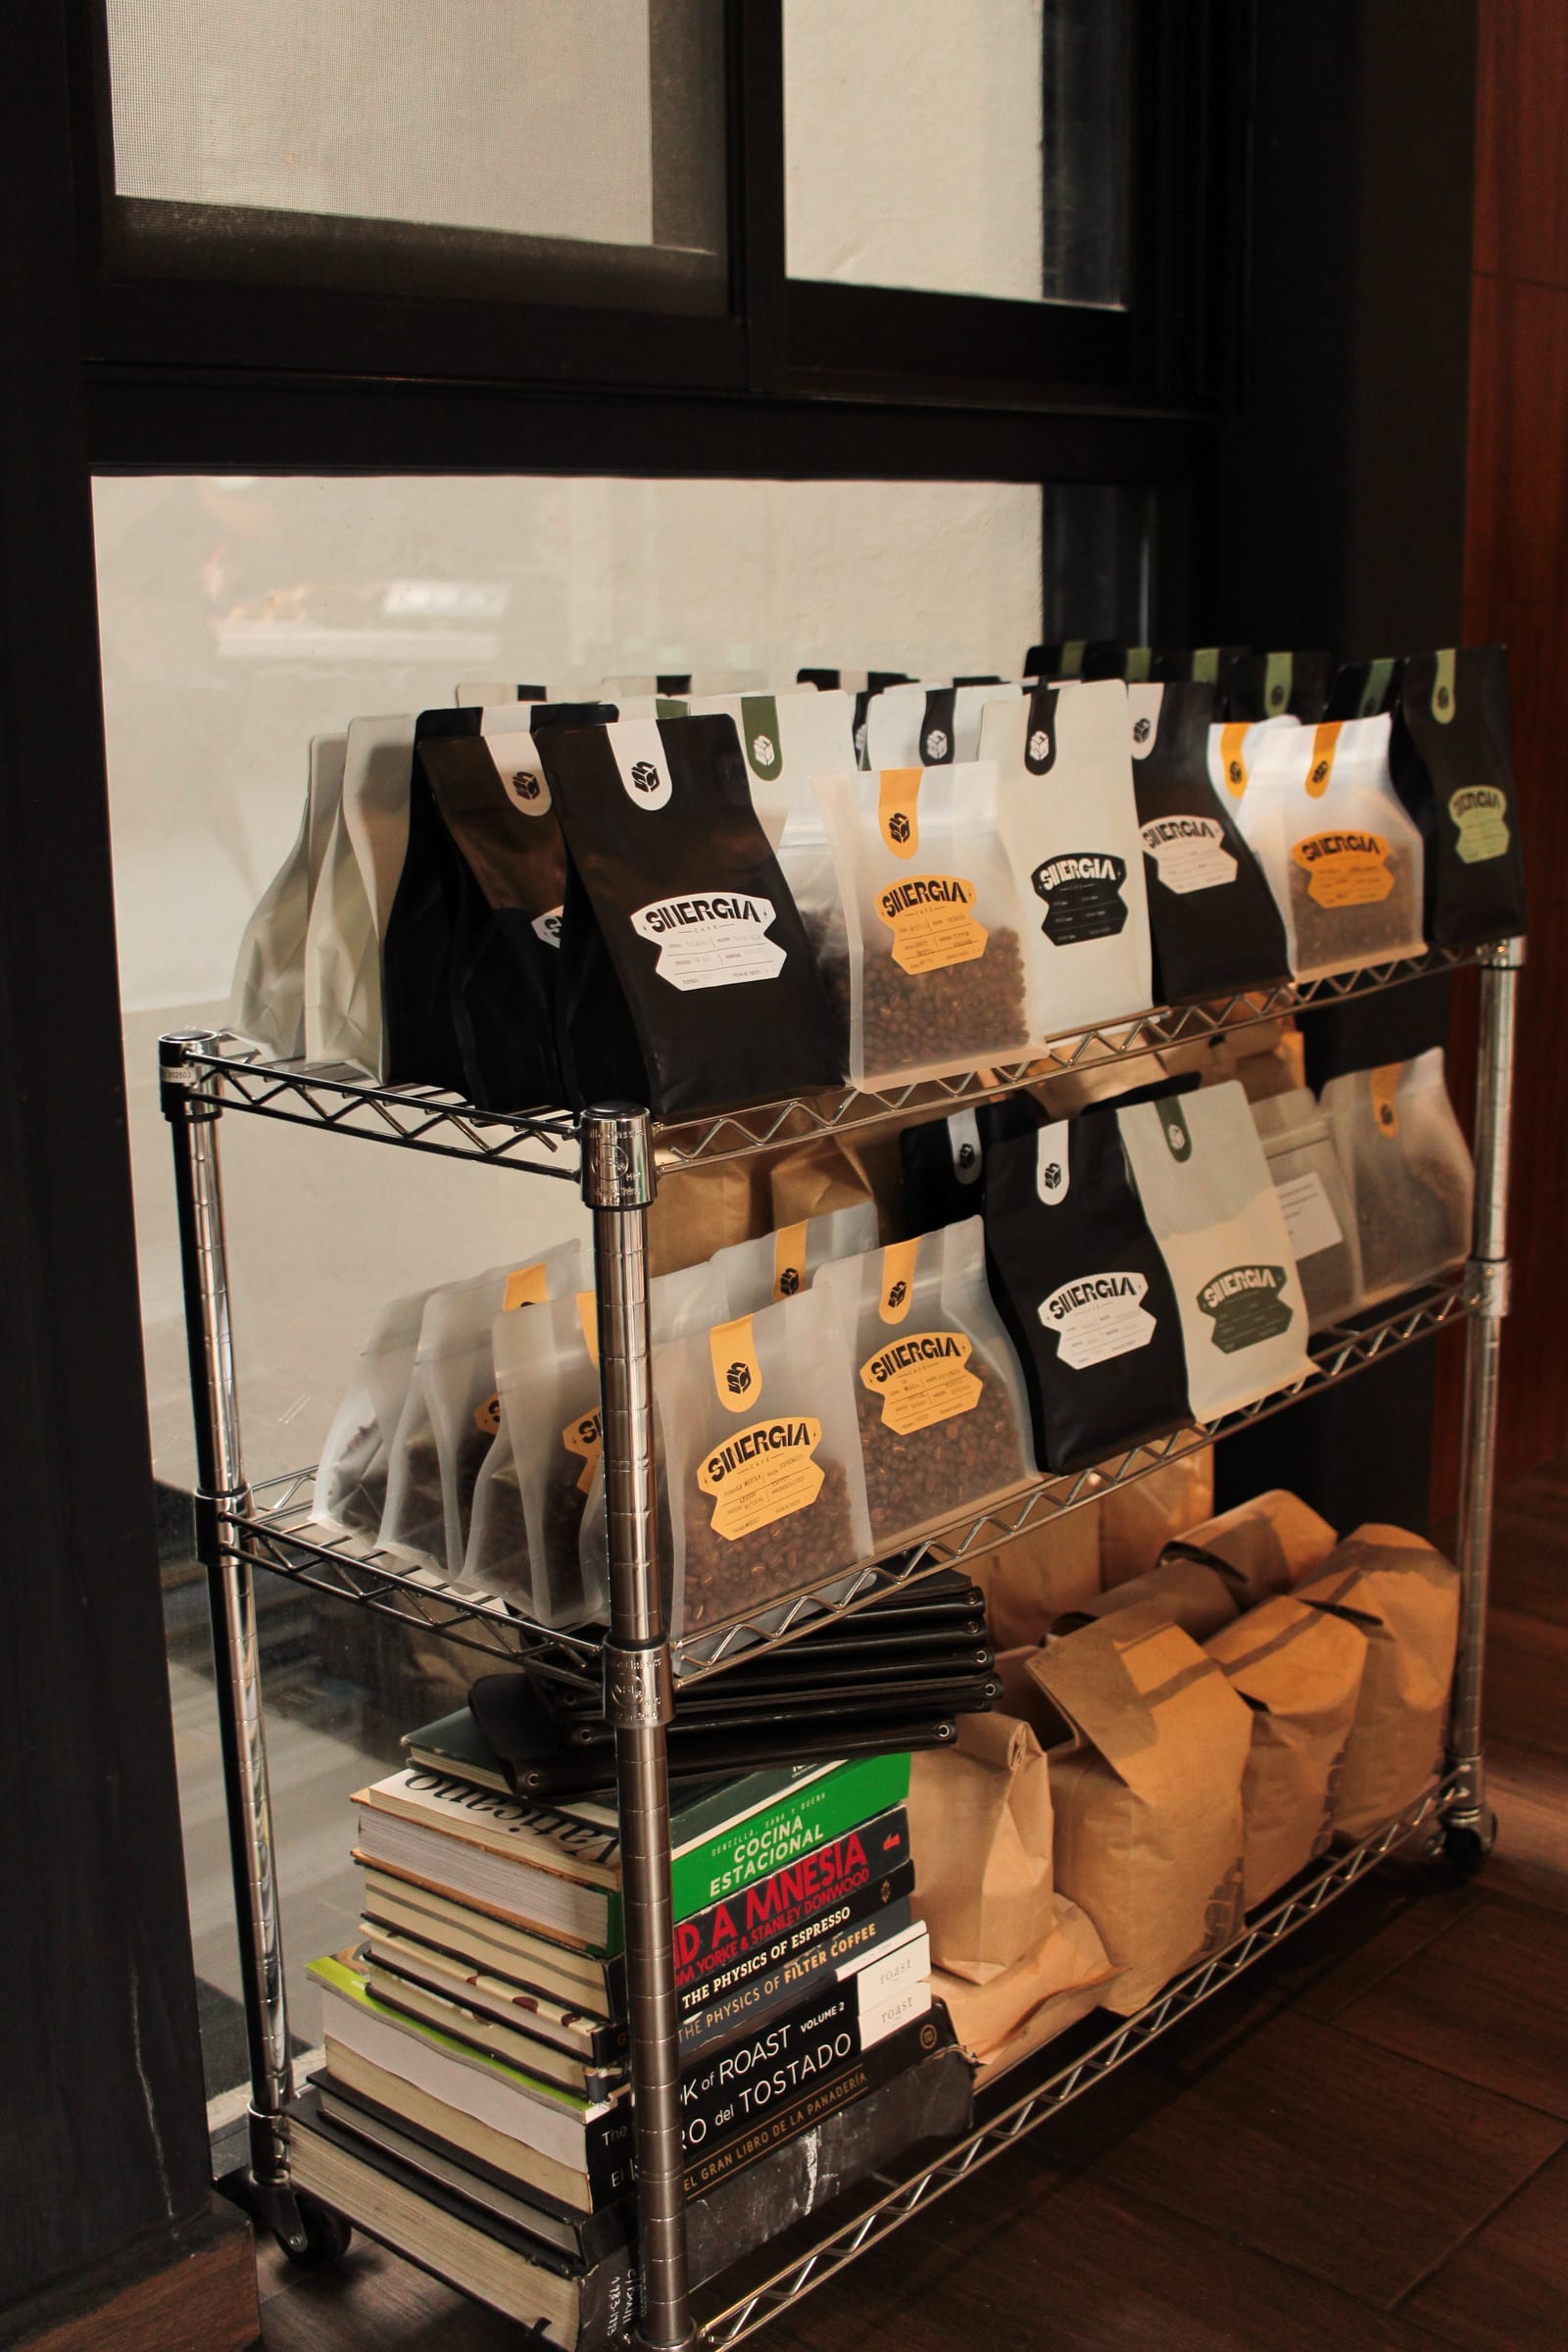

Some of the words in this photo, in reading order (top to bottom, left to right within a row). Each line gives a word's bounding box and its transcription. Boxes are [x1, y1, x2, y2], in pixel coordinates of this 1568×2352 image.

[882, 880, 968, 918] SINERGIA
[1040, 858, 1117, 891] SINERGIA
[645, 898, 761, 933] SINERGIA
[1049, 1277, 1138, 1320] SINERGIA
[1203, 1268, 1277, 1308] SINERGIA
[871, 1337, 962, 1383] SINERGIA
[708, 1423, 810, 1483] SINERGIA
[405, 1772, 620, 1864] Vaticano
[734, 1815, 804, 1863] COCINA
[710, 1824, 824, 1897] ESTACIONAL
[674, 1923, 701, 1970] ID
[711, 1902, 738, 1950] A
[746, 1832, 868, 1930] MNESIA
[697, 1945, 738, 1976] YORKE
[740, 1936, 750, 1951] &
[751, 1904, 802, 1943] STANLEY
[805, 1868, 870, 1916] DONWOOD
[678, 2020, 703, 2044] THE
[707, 1986, 760, 2029] PHYSICS
[763, 1976, 780, 1995] OF
[784, 1950, 827, 1984] FILTER
[831, 1923, 876, 1957] COFFEE
[681, 1984, 710, 2009] THE
[712, 1953, 768, 1992] PHYSICS
[770, 1941, 789, 1959] OF
[792, 1906, 852, 1948] ESPRESSO
[880, 1959, 911, 1984] roast
[881, 1996, 913, 2024] roast
[701, 2071, 715, 2091] of
[719, 2024, 792, 2085] ROAST
[800, 2006, 837, 2034] VOLUME
[839, 2001, 845, 2012] 2
[714, 2104, 735, 2126] del
[739, 2033, 852, 2114] TOSTADO
[601, 2125, 628, 2146] The
[683, 2175, 698, 2191] EL
[701, 2153, 733, 2180] GRAN
[736, 2132, 769, 2160] LIBRO
[772, 2121, 787, 2137] DE
[790, 2110, 805, 2127] LA
[808, 2071, 867, 2117] PANADERÍA
